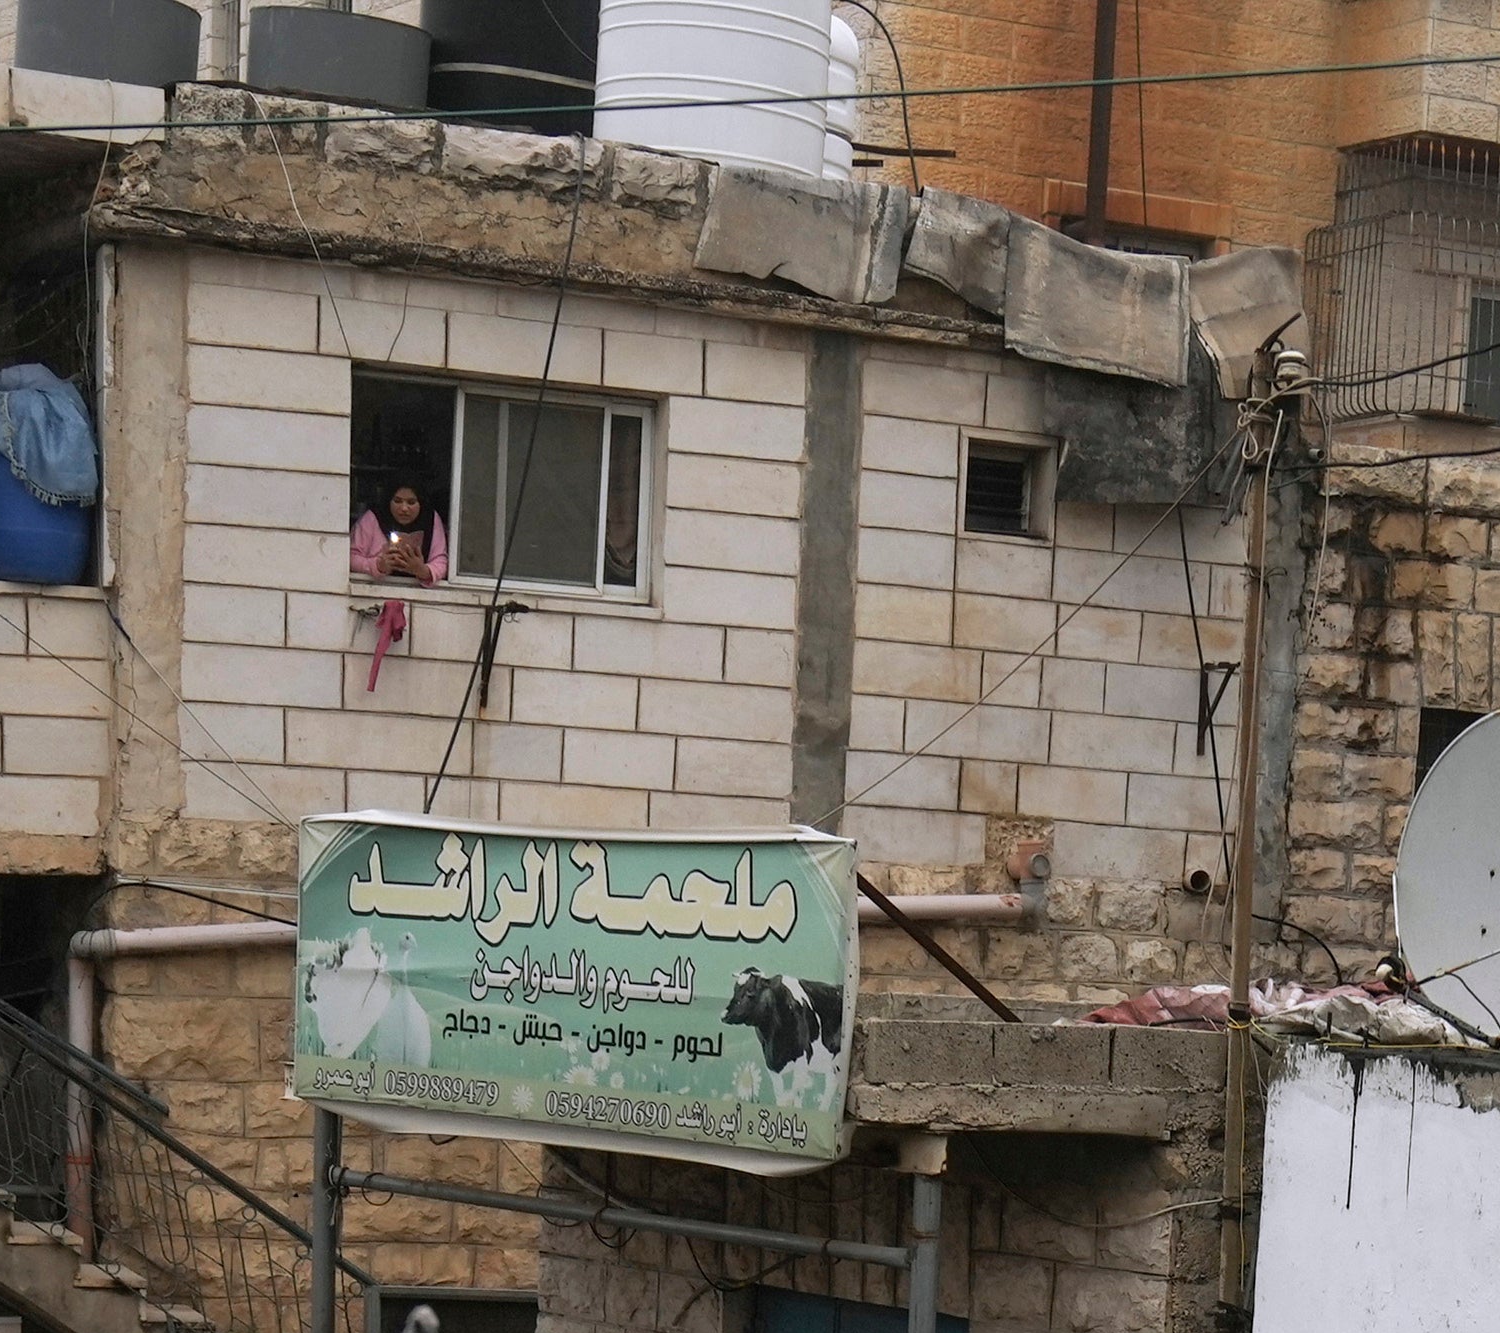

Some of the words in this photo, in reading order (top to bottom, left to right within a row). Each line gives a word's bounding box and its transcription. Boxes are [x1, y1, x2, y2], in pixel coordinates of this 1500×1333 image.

[348, 832, 560, 946] الراشد
[568, 840, 798, 943] ملحمة
[469, 946, 598, 1010] والدواجن
[601, 956, 697, 1014] للحوم
[441, 1008, 491, 1041] دجاج
[512, 1013, 564, 1047] حبش
[586, 1023, 646, 1056] دواجن
[671, 1031, 723, 1061] لحوم
[313, 1067, 354, 1092] عمرو
[353, 1061, 377, 1094] أبو
[384, 1069, 500, 1108] 0599889479
[544, 1089, 671, 1131] 0594270690
[675, 1105, 715, 1137] راشد
[715, 1102, 743, 1138] أبو
[757, 1114, 809, 1147] بإدارة
